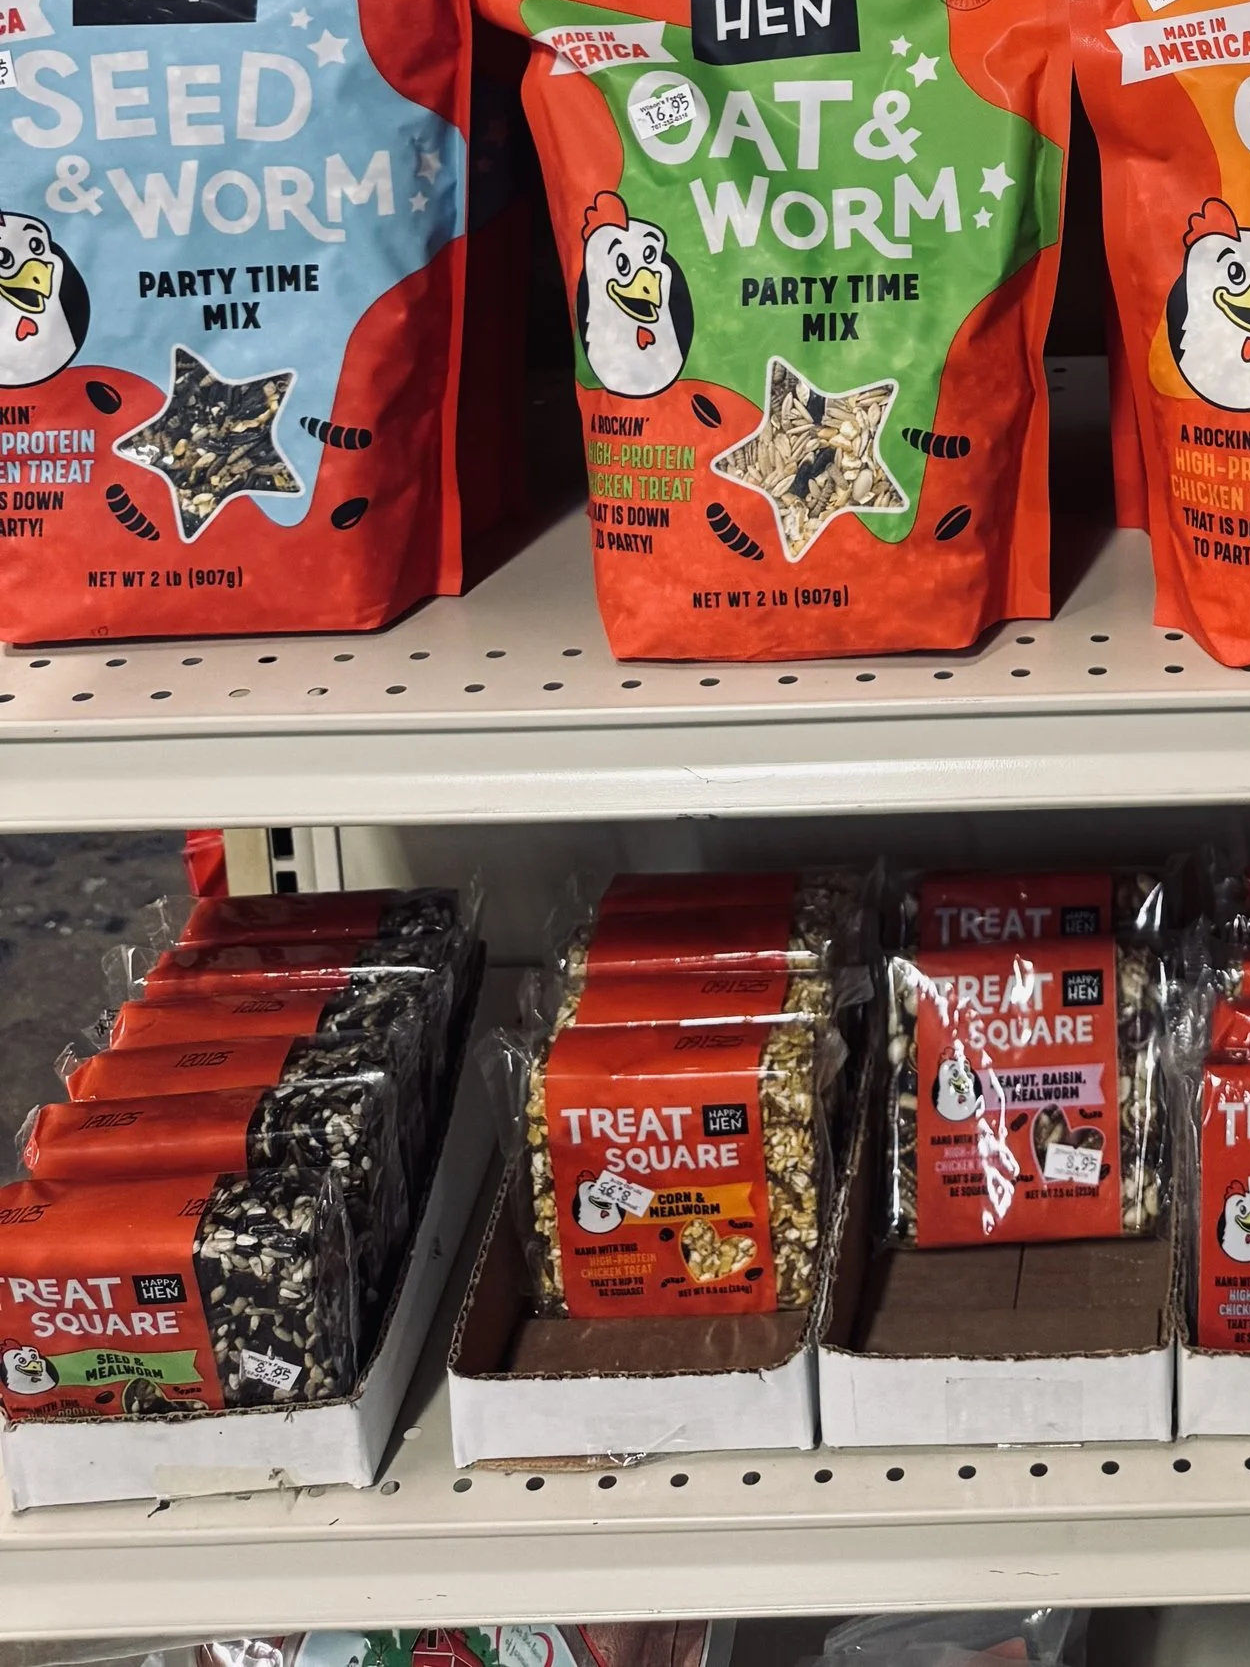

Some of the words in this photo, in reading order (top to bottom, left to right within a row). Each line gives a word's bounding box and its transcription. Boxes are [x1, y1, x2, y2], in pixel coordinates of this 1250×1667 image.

[1163, 21, 1206, 40] MADE
[1209, 17, 1227, 34] IN
[12, 50, 312, 149] SEED
[645, 96, 689, 124] 16.95
[627, 70, 853, 172] OAT
[854, 90, 922, 164] &
[45, 155, 104, 216] &
[107, 150, 395, 242] WORM
[689, 166, 962, 258] WORM
[139, 268, 236, 298] PARTY
[246, 264, 319, 292] TIME
[204, 302, 261, 330] MIX
[1180, 425, 1191, 444] A
[1171, 473, 1244, 510] CHICKEN
[937, 974, 1052, 1015] TREAT
[968, 1015, 1093, 1049] SQUARE
[561, 1107, 692, 1145] TREAT
[605, 1143, 740, 1174] SQUARE
[649, 1204, 720, 1218] MEALWORM
[658, 1192, 692, 1205] CORN
[694, 1193, 706, 1203] &
[32, 1311, 180, 1337] SQUARE
[86, 1367, 163, 1381] MEALWORM
[97, 1354, 130, 1365] SEED
[134, 1357, 144, 1366] &
